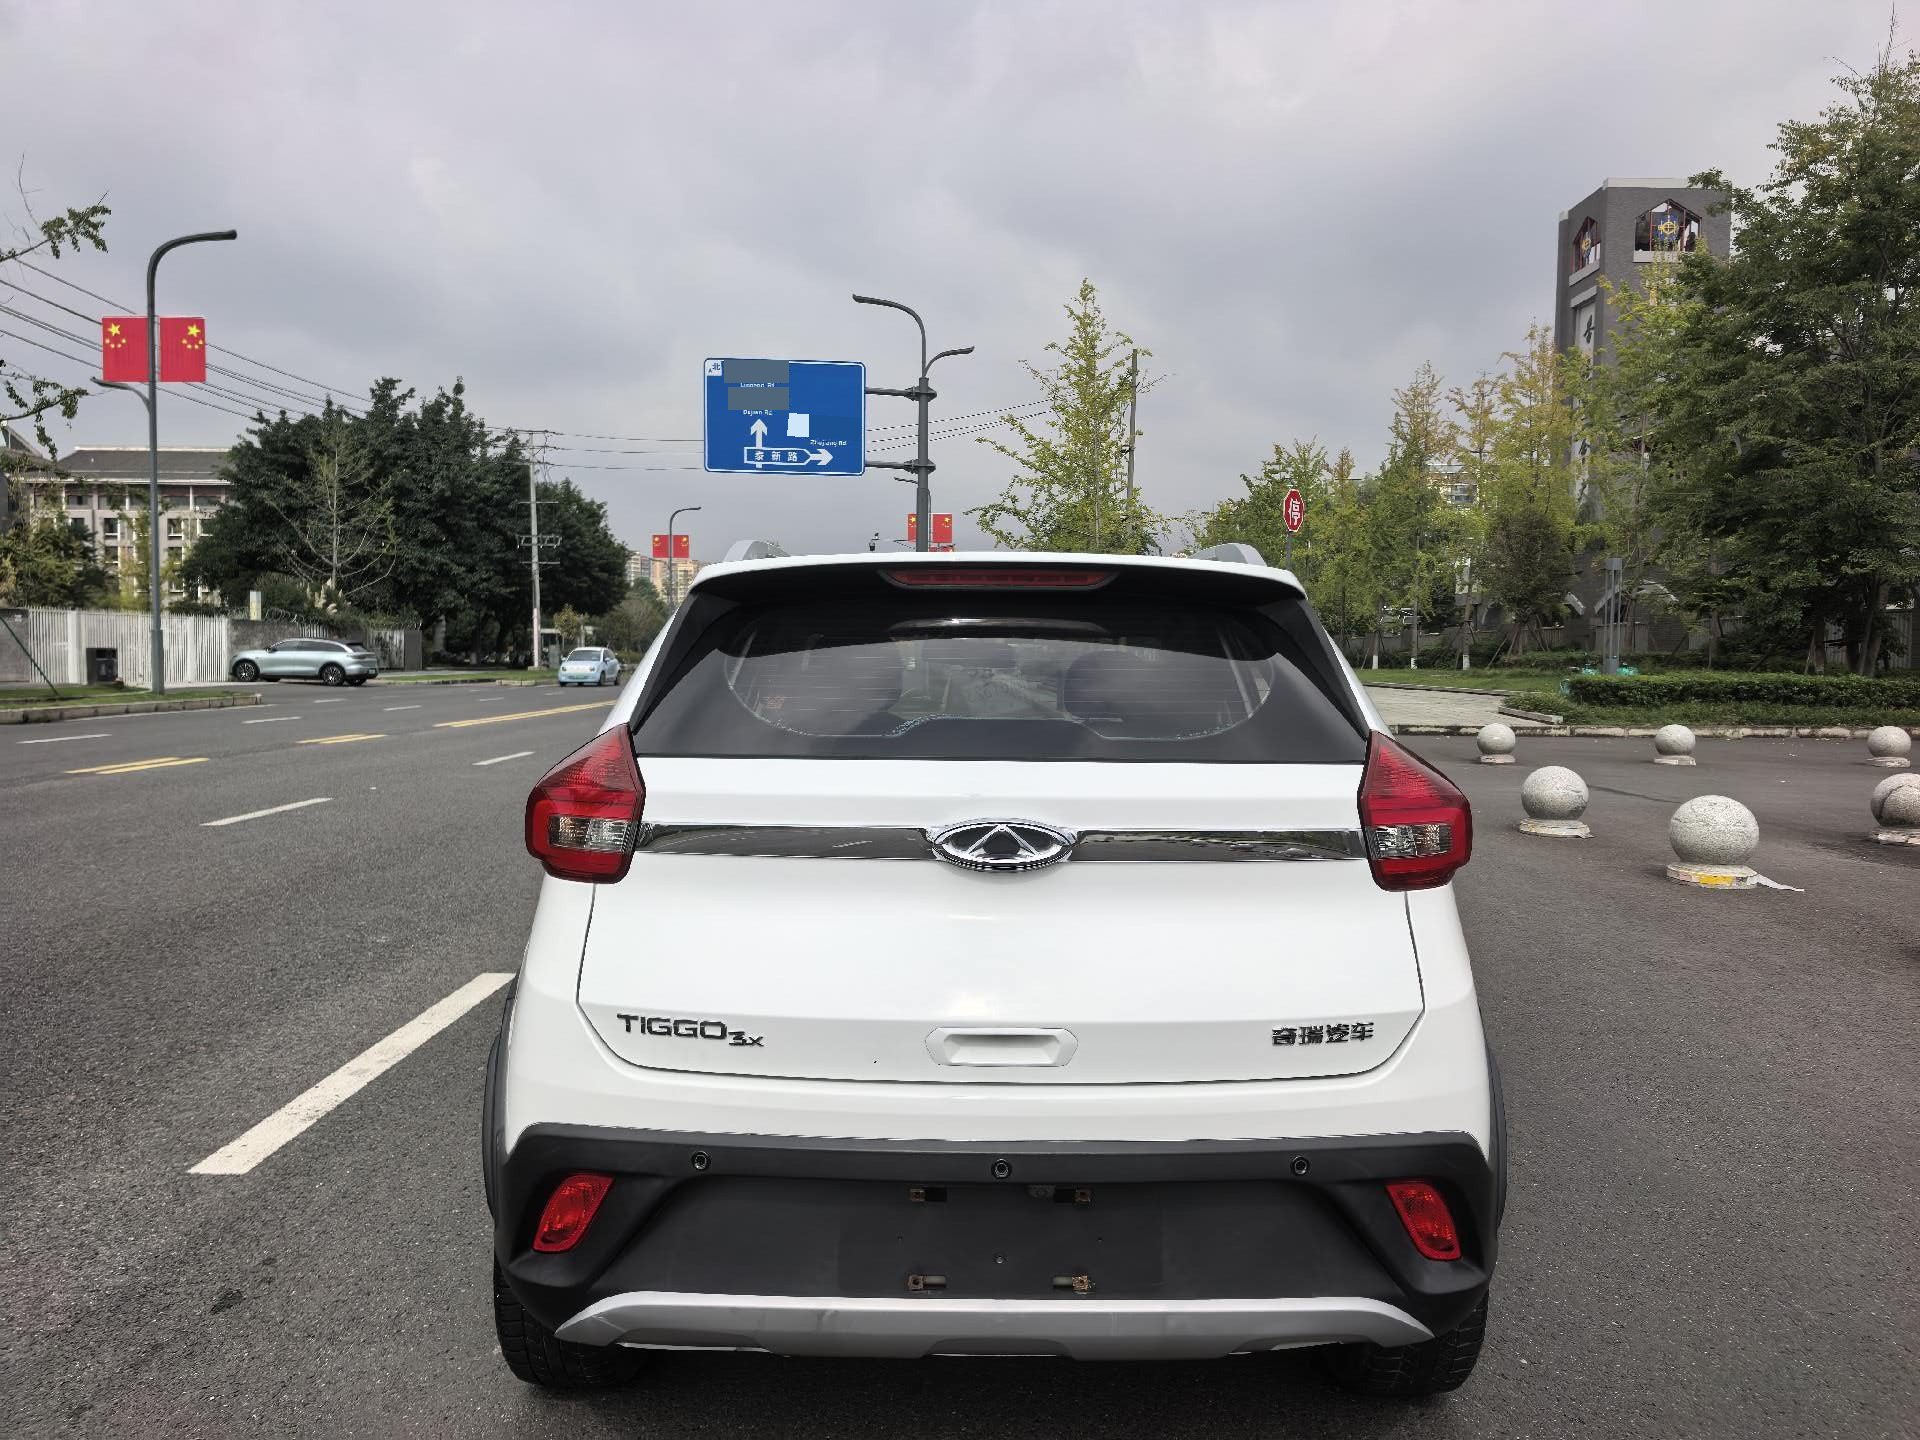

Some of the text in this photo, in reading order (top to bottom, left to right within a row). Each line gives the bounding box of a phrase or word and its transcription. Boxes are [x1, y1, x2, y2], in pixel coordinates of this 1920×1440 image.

[711, 362, 721, 371] 北
[1288, 498, 1301, 526] 停
[617, 1013, 728, 1040] TIGGO
[1271, 1022, 1374, 1046] 奇瑞汽车
